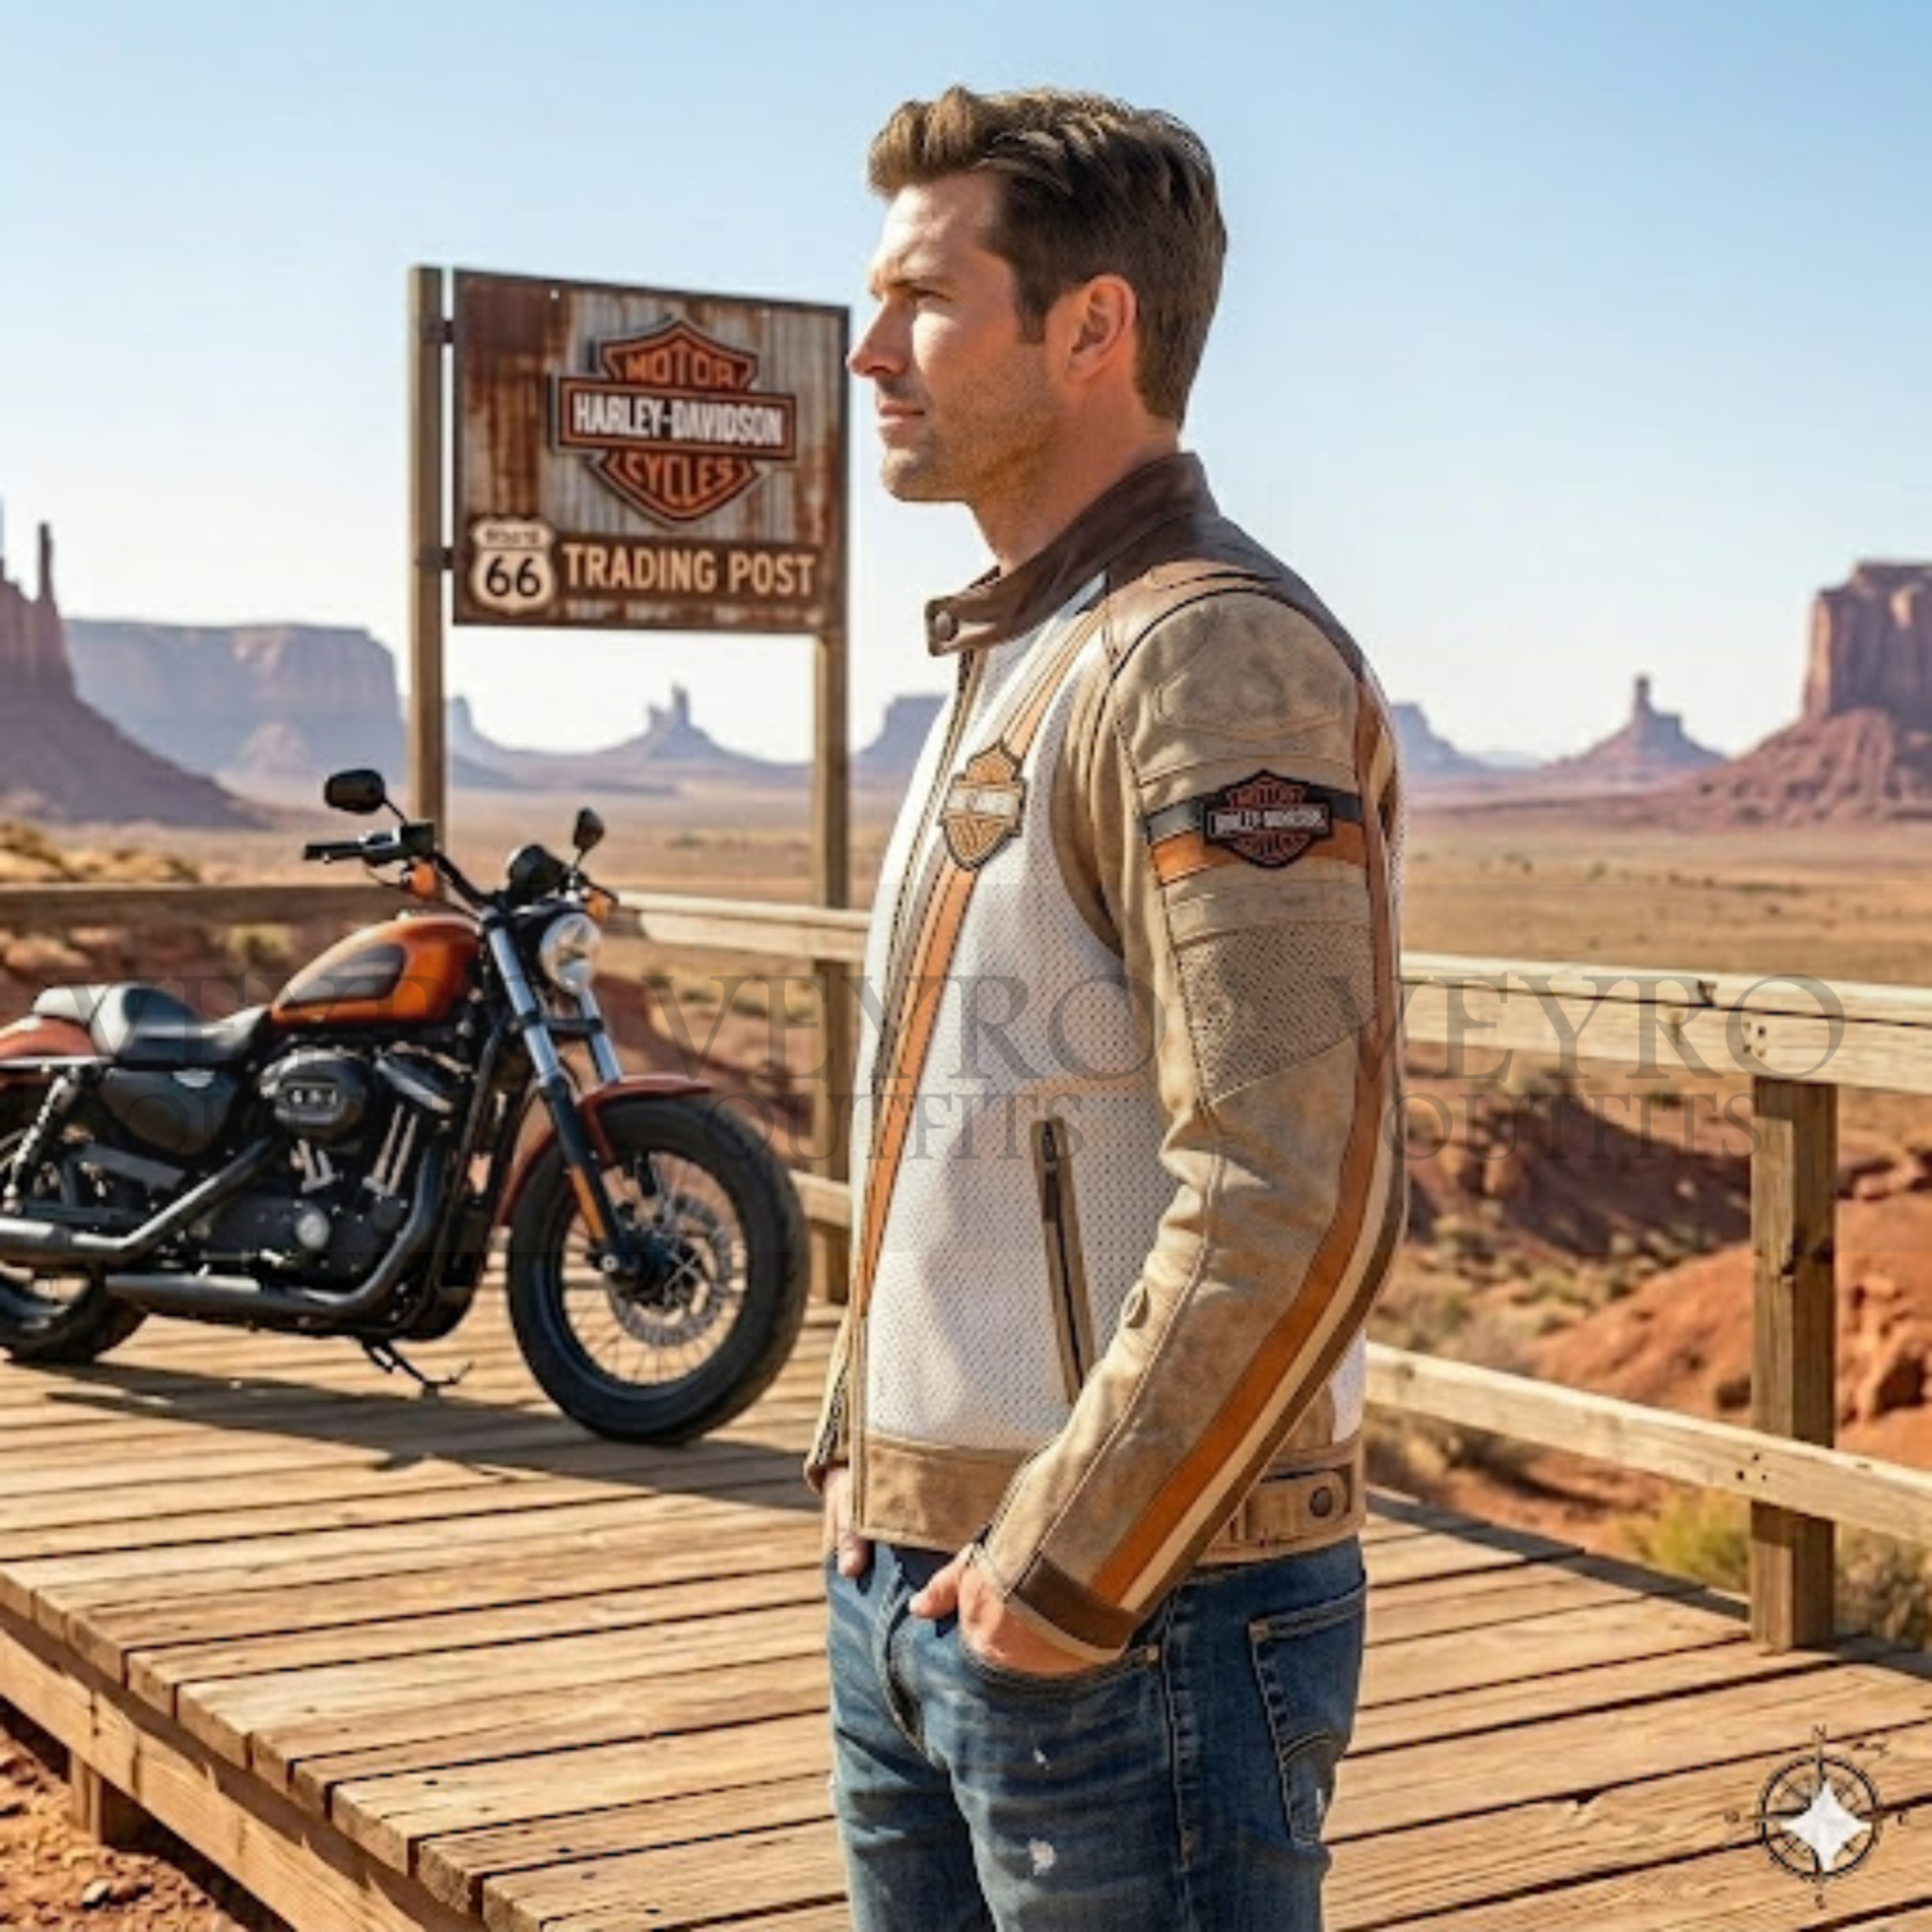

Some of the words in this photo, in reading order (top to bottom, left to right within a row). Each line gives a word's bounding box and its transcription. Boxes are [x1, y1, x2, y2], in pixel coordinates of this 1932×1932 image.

[625, 341, 738, 390] MOTOR
[573, 391, 785, 447] HARLEY-DAVIDSON
[625, 451, 735, 508] CYCLES
[486, 555, 541, 597] 66
[562, 543, 718, 593] TRADING
[728, 549, 817, 597] POST
